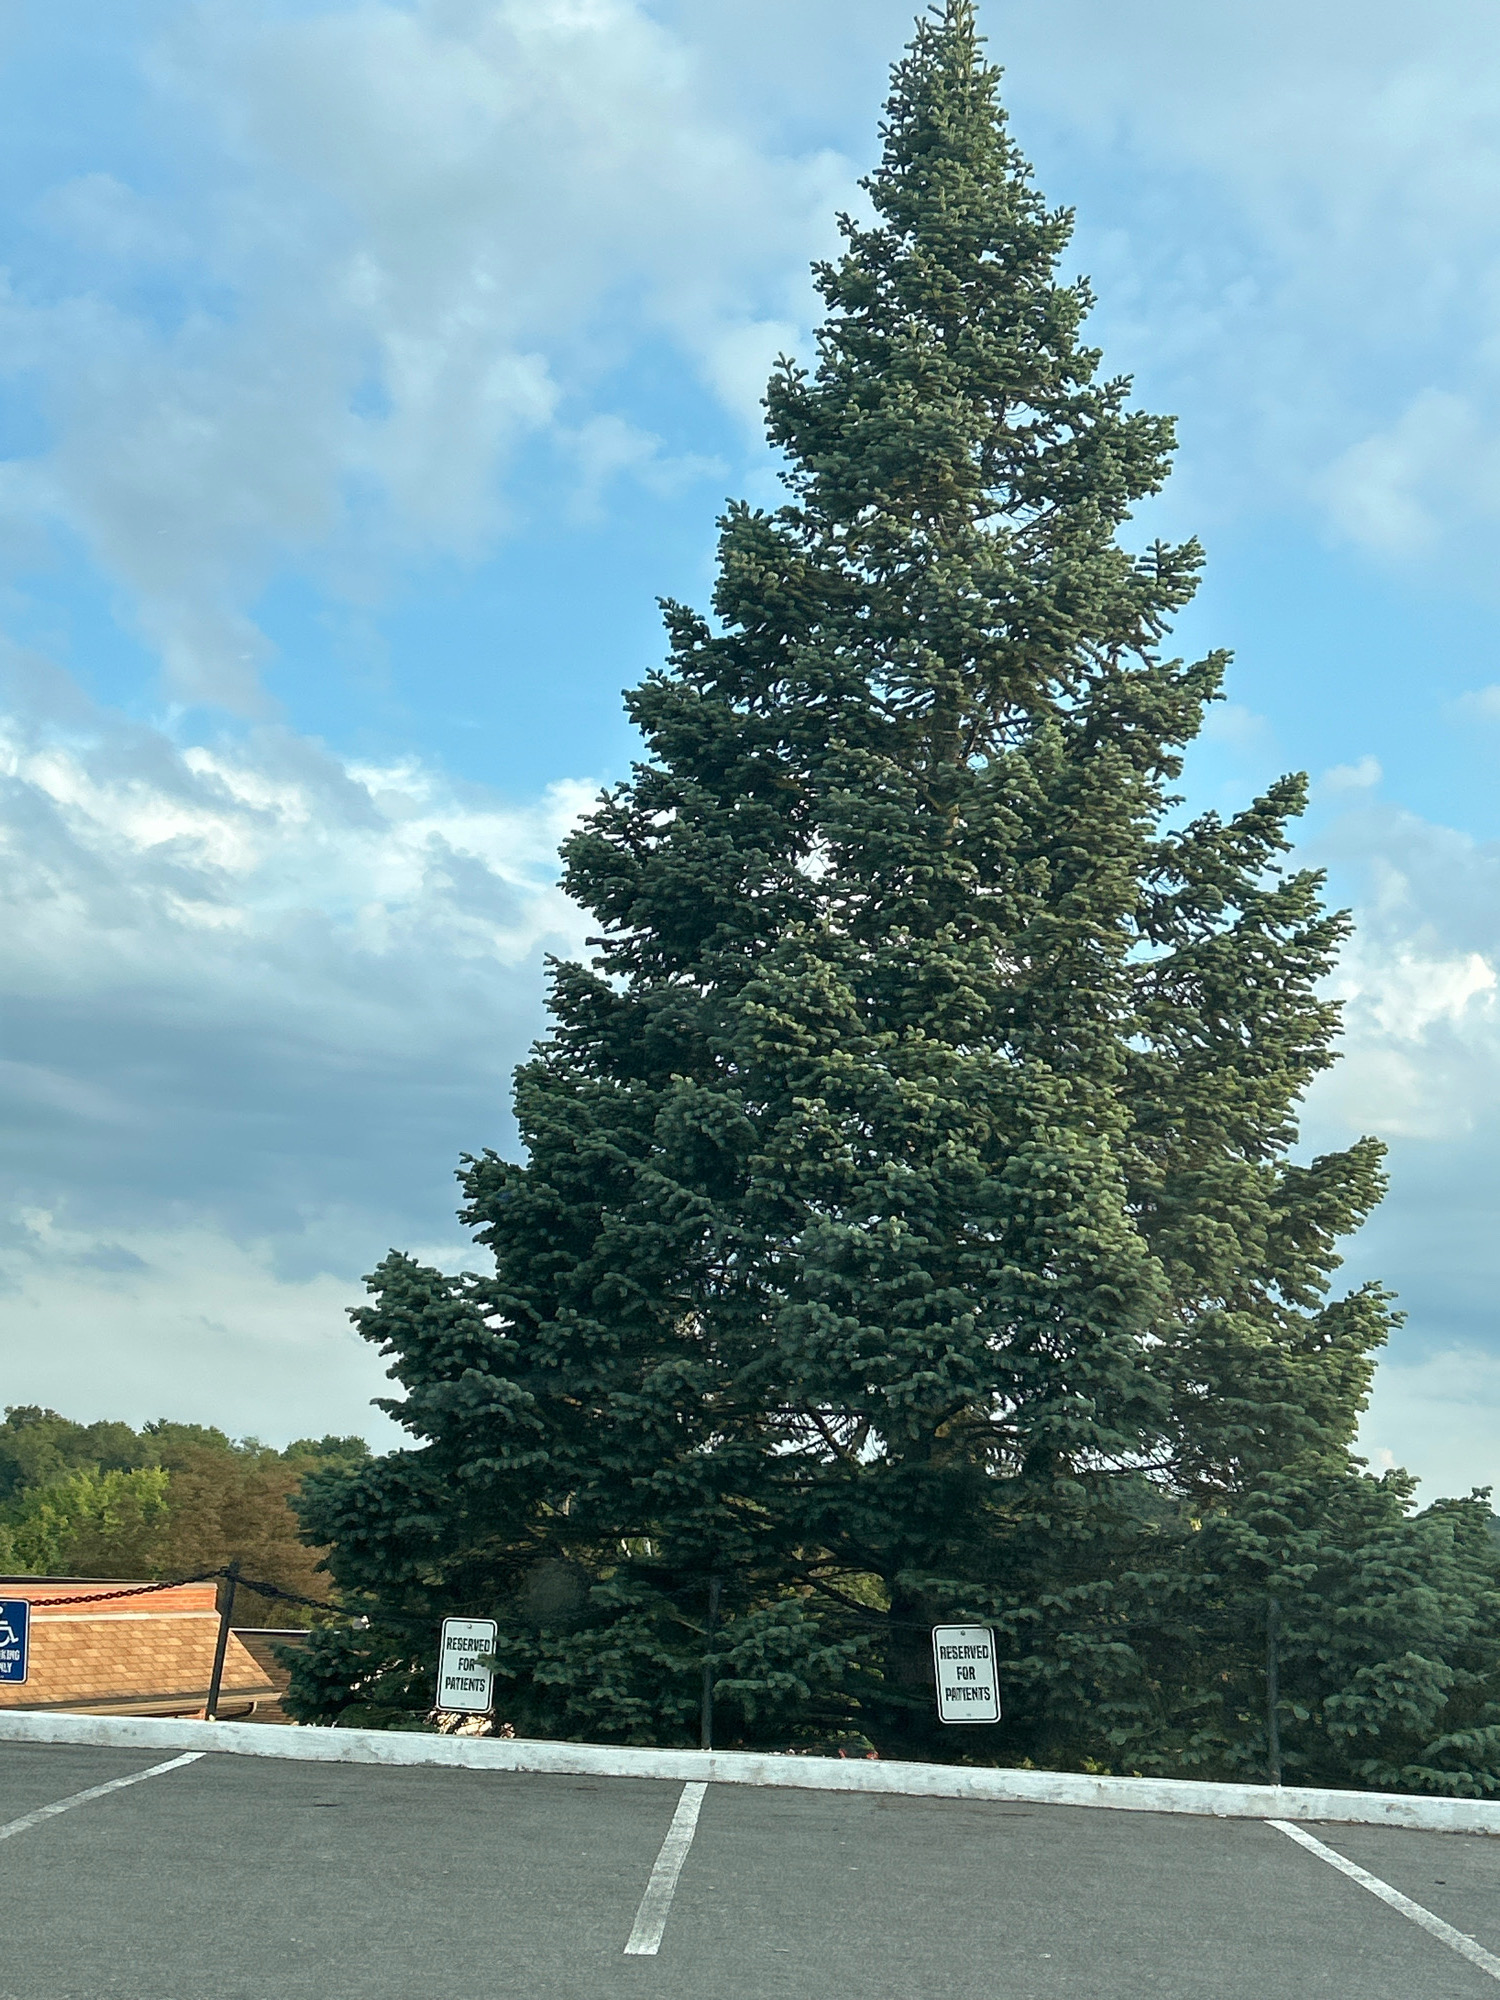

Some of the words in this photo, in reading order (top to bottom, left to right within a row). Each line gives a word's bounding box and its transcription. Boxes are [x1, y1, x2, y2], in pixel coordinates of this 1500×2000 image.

[446, 1637, 491, 1652] RESERVED
[940, 1645, 989, 1660] RESERVED
[458, 1657, 475, 1671] FOR
[957, 1666, 976, 1680] FOR
[445, 1677, 485, 1692] PATIENTS
[945, 1687, 991, 1701] PATIENTS
